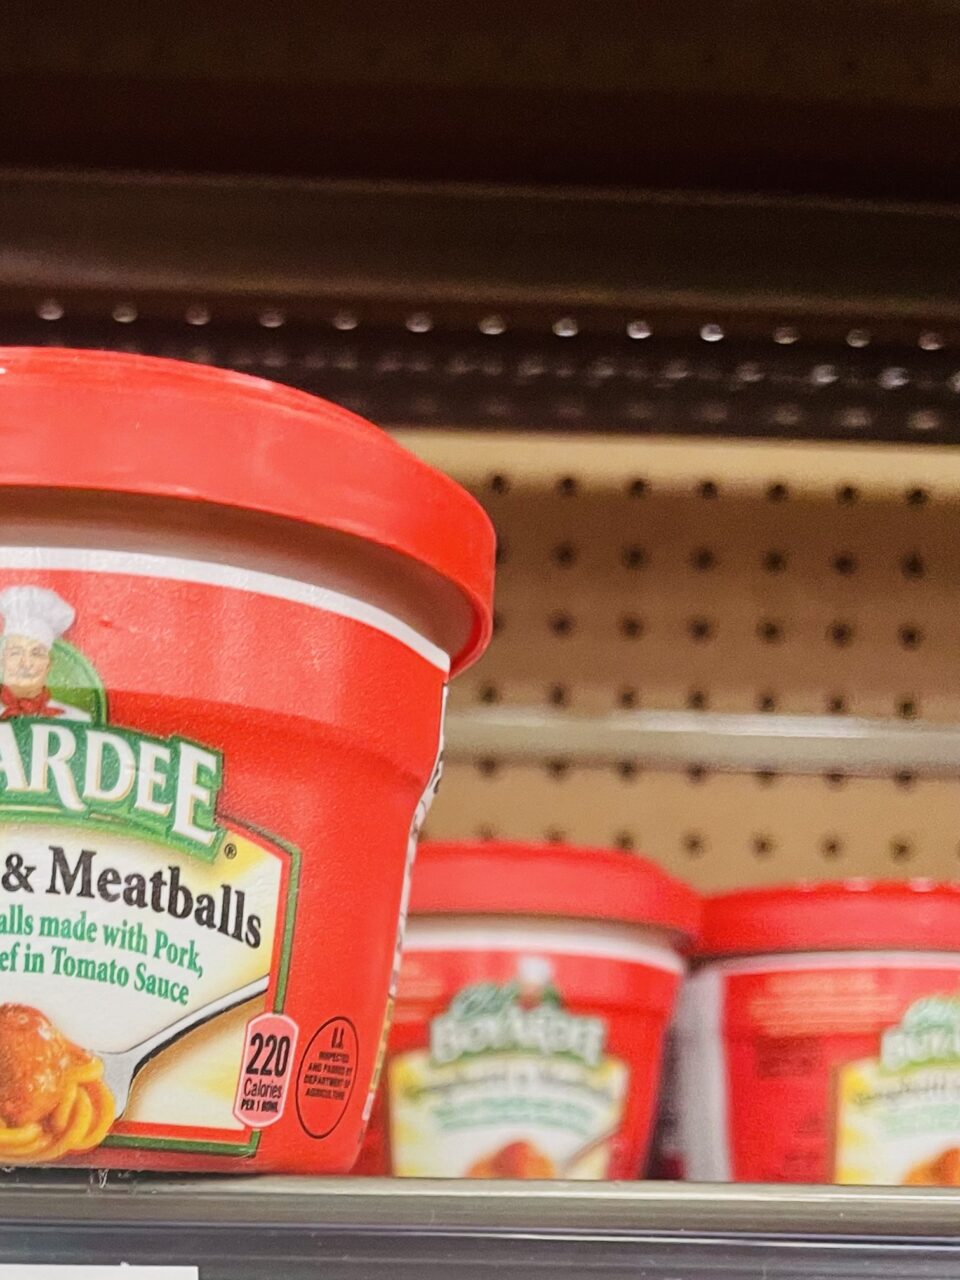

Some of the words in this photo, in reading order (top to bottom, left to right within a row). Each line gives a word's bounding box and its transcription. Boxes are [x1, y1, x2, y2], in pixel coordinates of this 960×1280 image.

[1, 851, 37, 893] &
[45, 845, 261, 949] Meatballs
[23, 943, 45, 974] in
[51, 945, 130, 987] Tomato
[134, 962, 190, 1005] Sauce
[38, 910, 97, 943] made
[102, 919, 148, 957] with
[153, 929, 203, 979] Pork,
[246, 1032, 290, 1077] 220
[244, 1078, 282, 1099] Calories
